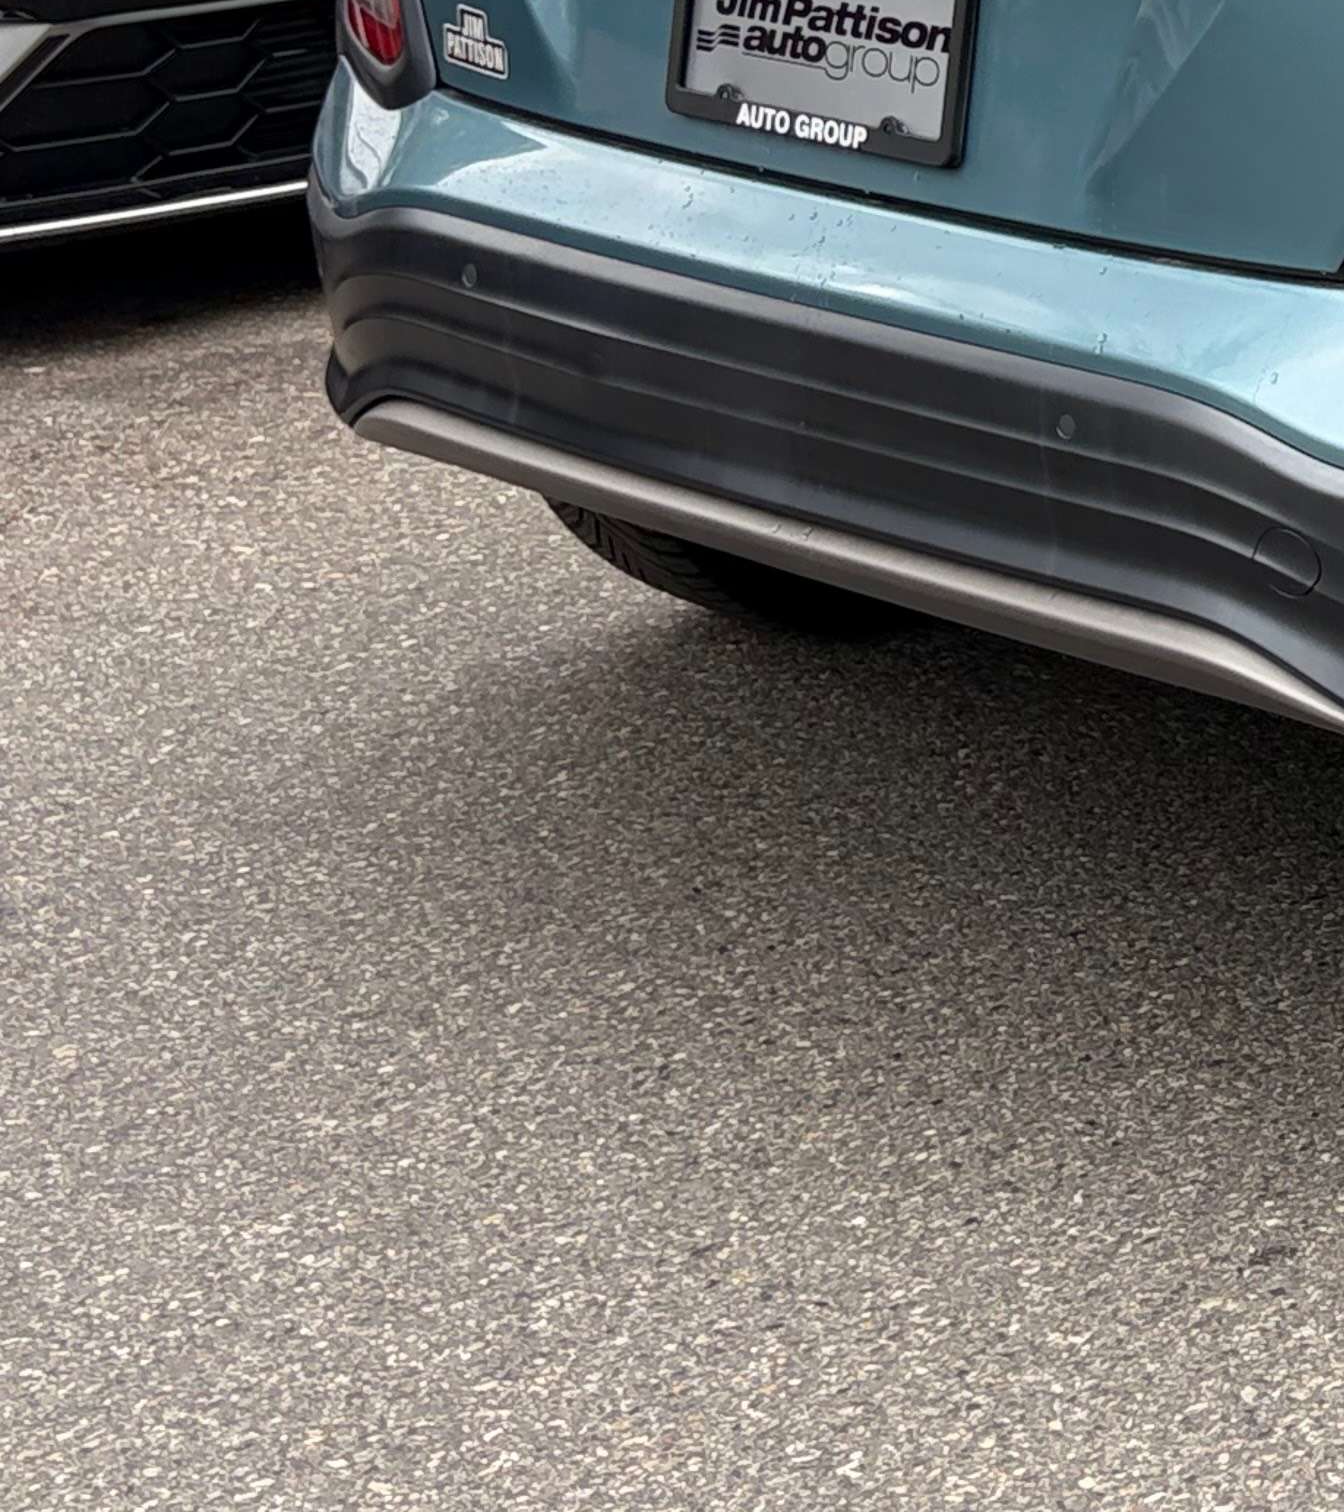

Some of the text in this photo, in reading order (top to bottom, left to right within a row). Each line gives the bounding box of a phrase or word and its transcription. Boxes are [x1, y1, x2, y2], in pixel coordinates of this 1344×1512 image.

[461, 13, 485, 42] JIM
[447, 31, 504, 73] PATTISON
[736, 103, 868, 150] AUTO GROUP
